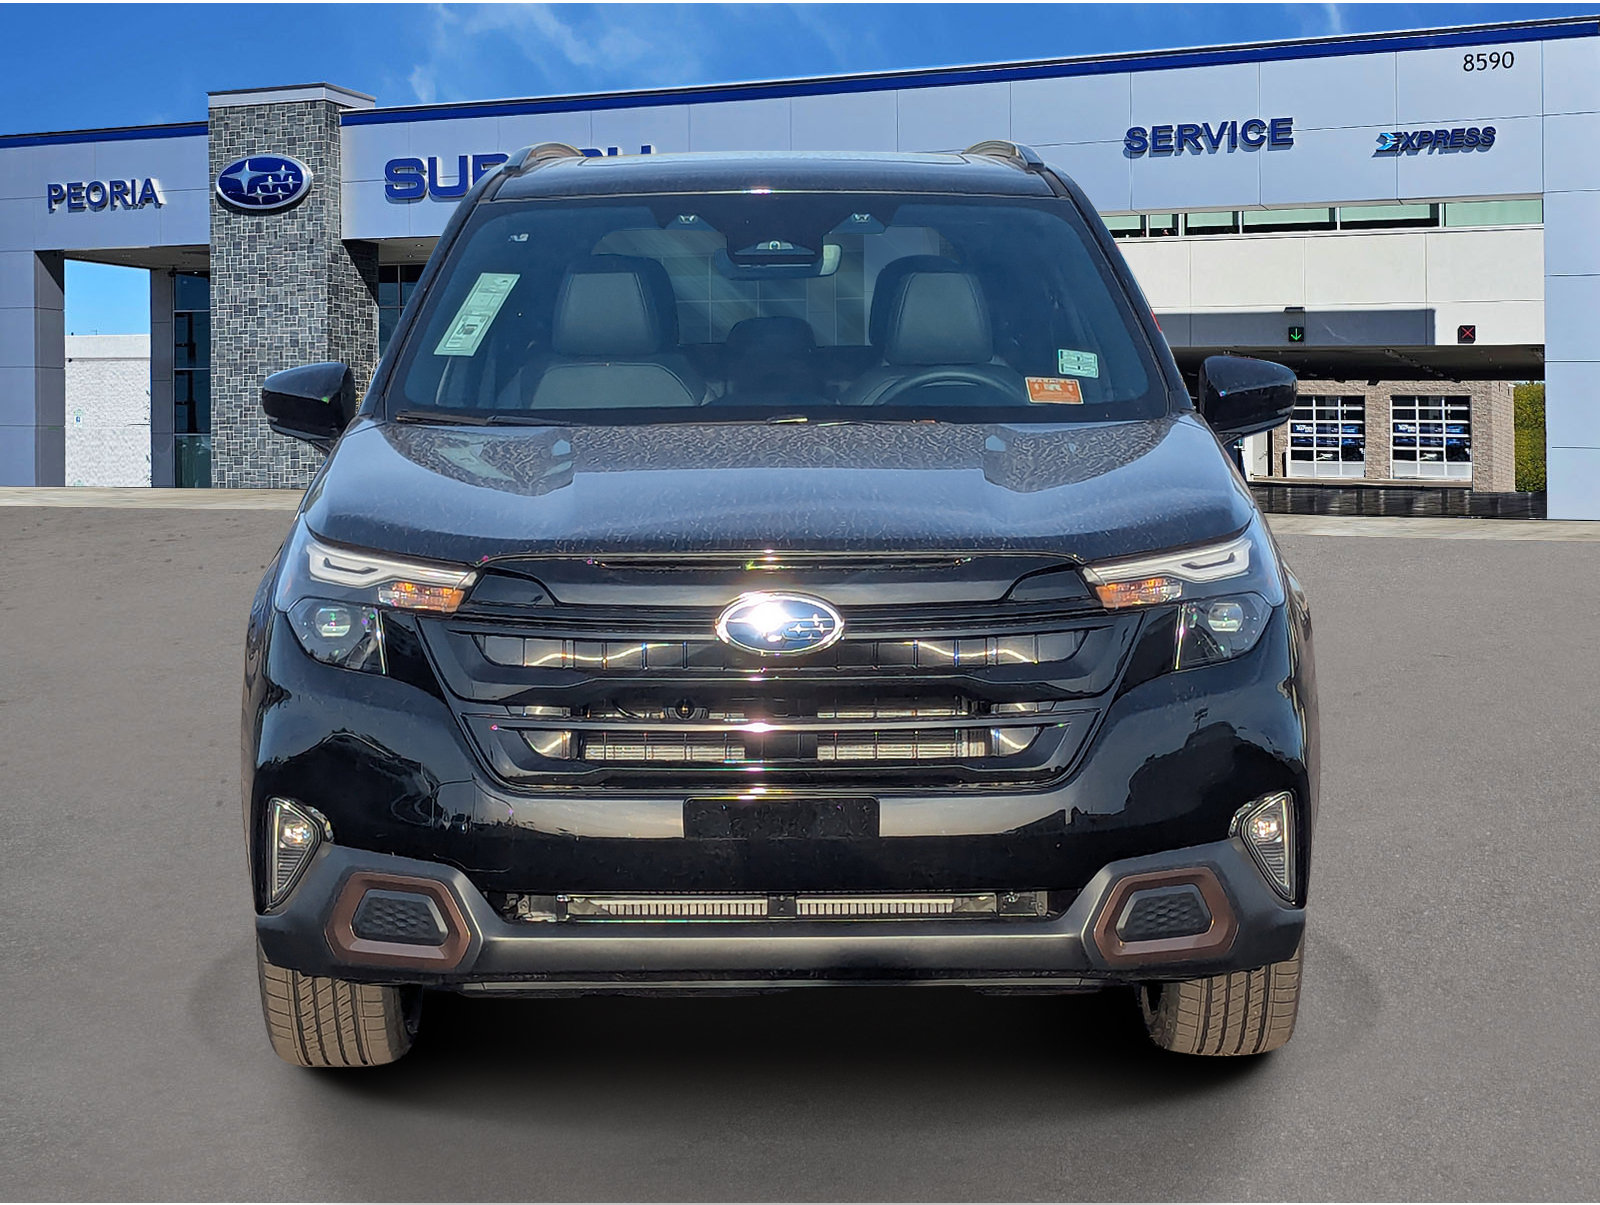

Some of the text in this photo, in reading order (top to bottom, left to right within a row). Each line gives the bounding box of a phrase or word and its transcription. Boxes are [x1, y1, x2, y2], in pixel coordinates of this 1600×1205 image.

[1463, 51, 1515, 72] 8590
[1125, 117, 1294, 153] SERVICE
[1375, 126, 1497, 151] EXPRESS
[47, 178, 161, 210] PEORIA
